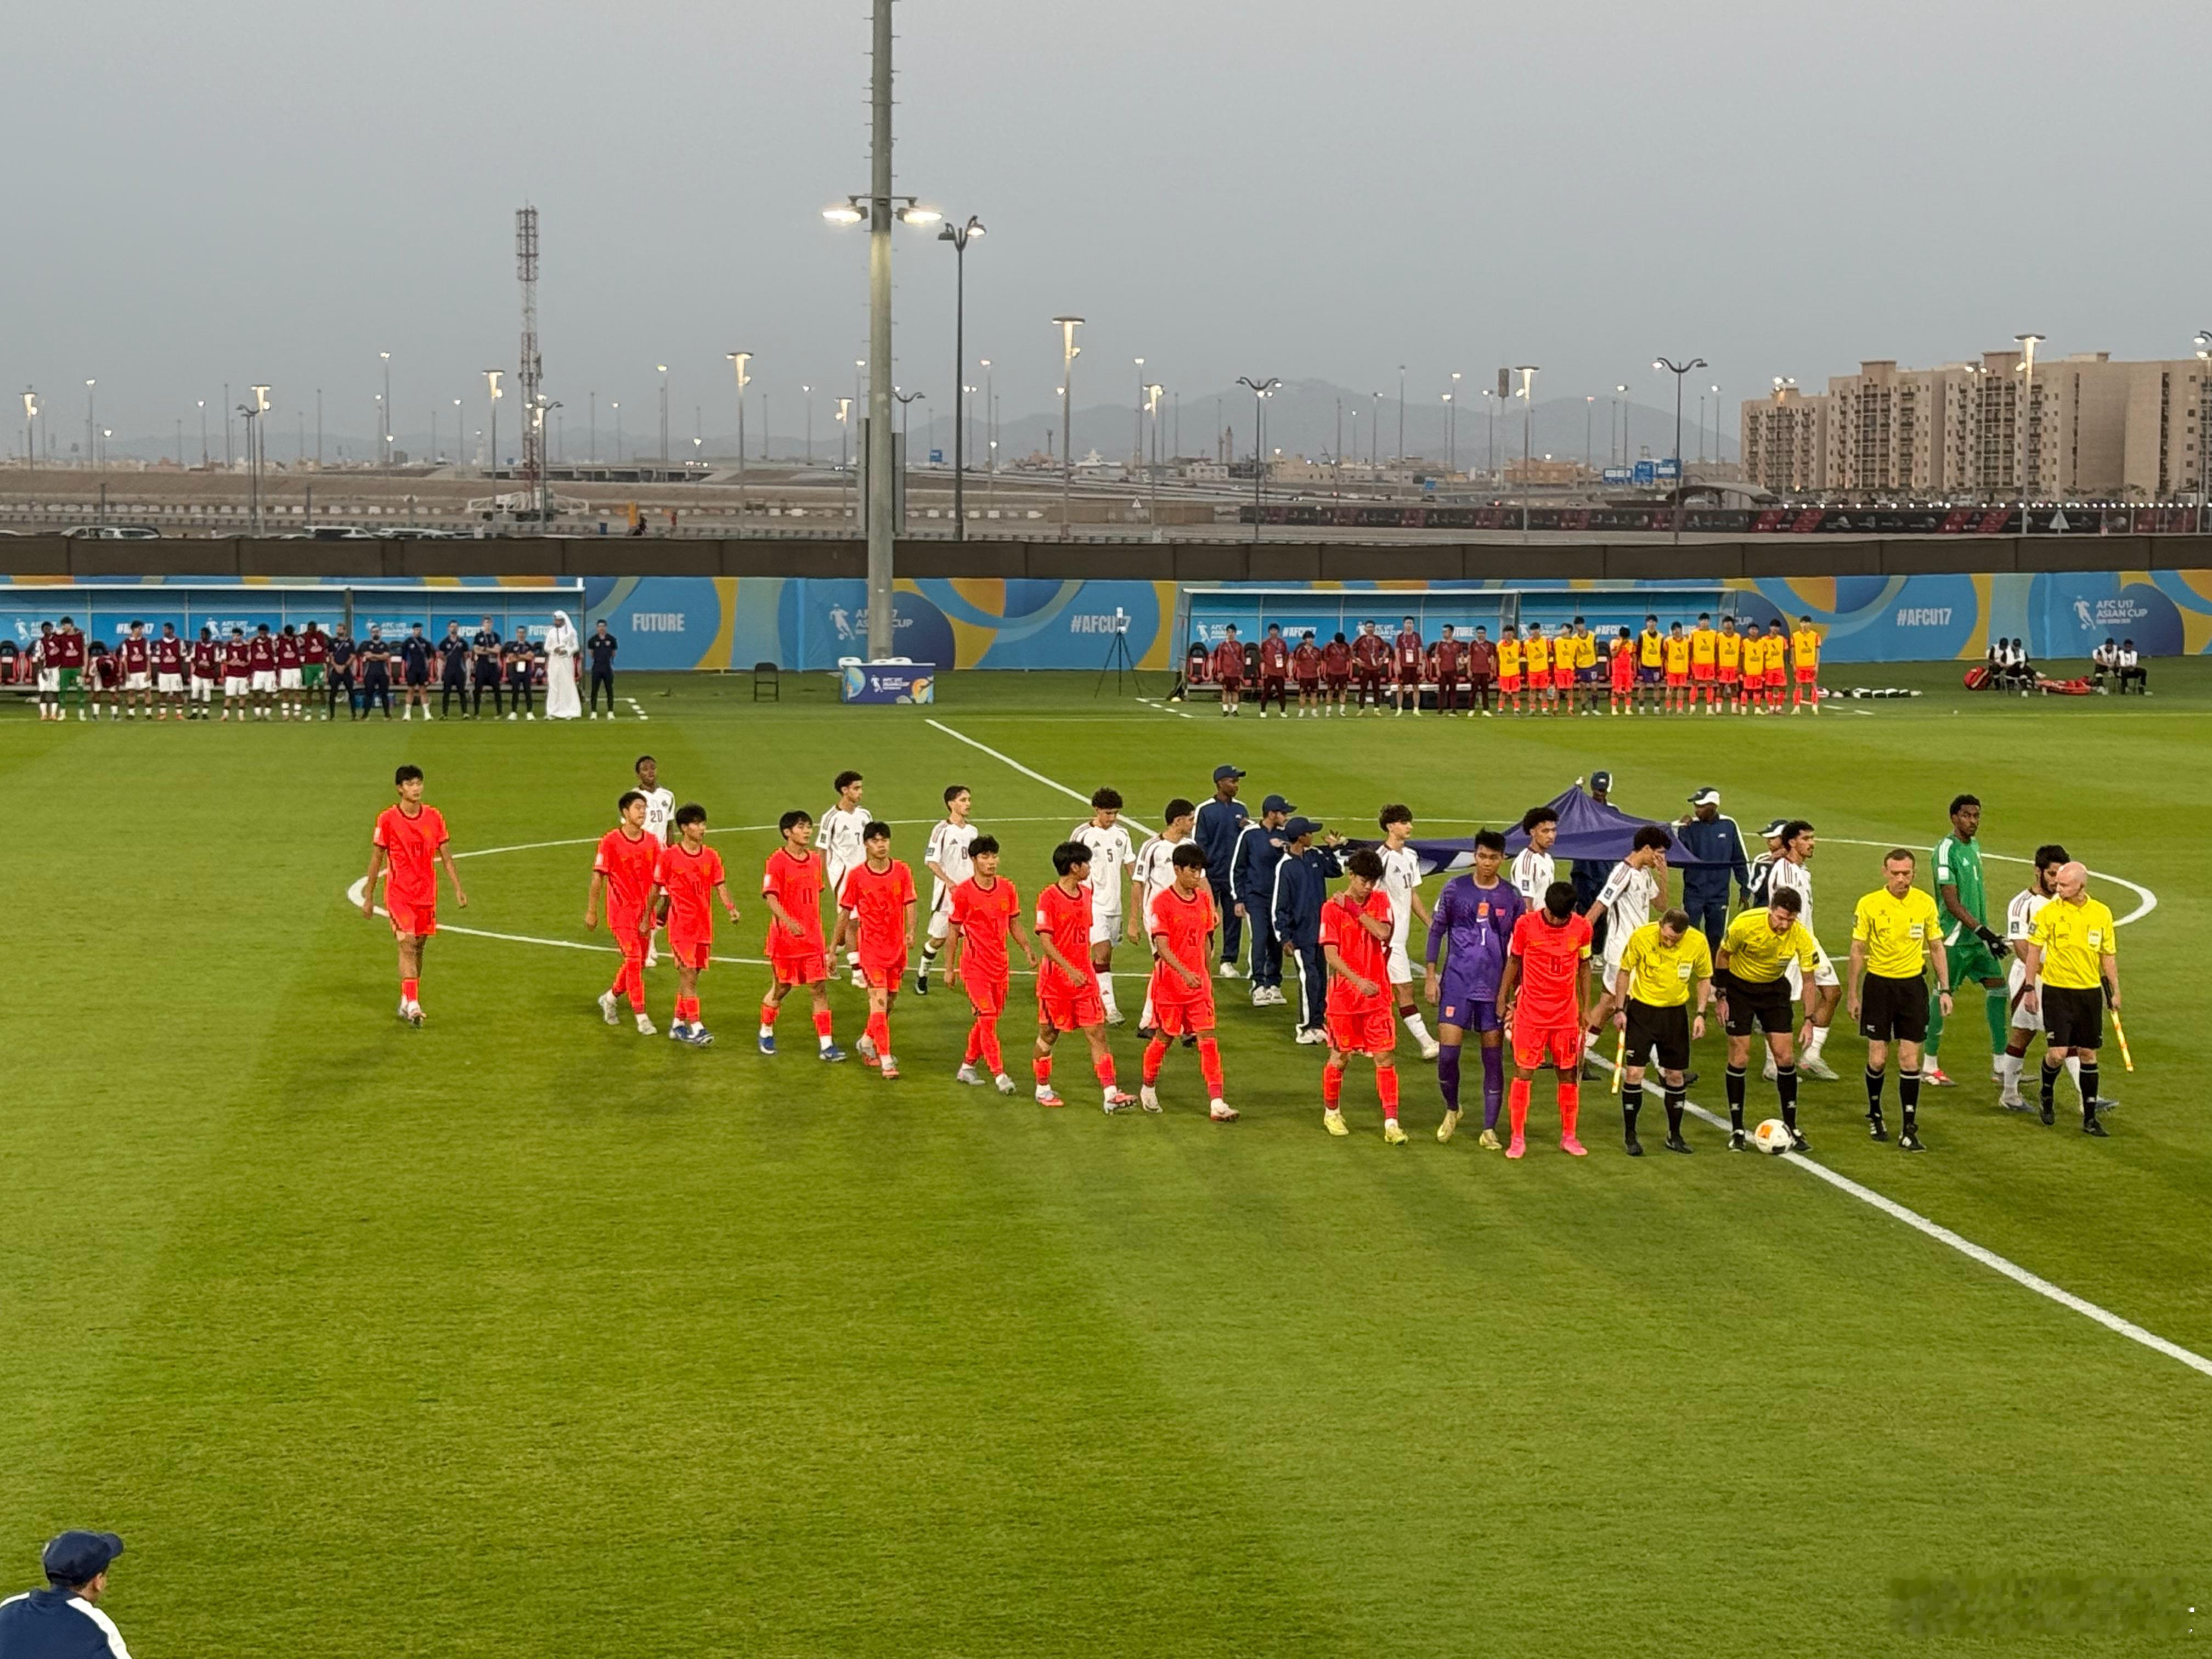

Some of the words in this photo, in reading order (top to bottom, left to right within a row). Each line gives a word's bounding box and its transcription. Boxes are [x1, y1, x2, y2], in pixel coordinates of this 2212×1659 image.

[2096, 600, 2115, 609] AFC
[2118, 600, 2134, 608] U17
[1897, 608, 1953, 626] #AFCU17
[2097, 609, 2126, 618] ASIAN
[2128, 608, 2148, 617] CUP
[633, 613, 685, 631] FUTURE
[651, 810, 663, 822] 20
[855, 832, 860, 845] 7
[1107, 849, 1113, 863] 5
[803, 888, 812, 904] 11
[1073, 927, 1086, 944] 15
[1188, 928, 1197, 946] 5
[1481, 928, 1486, 946] 1
[1550, 955, 1561, 974] 6
